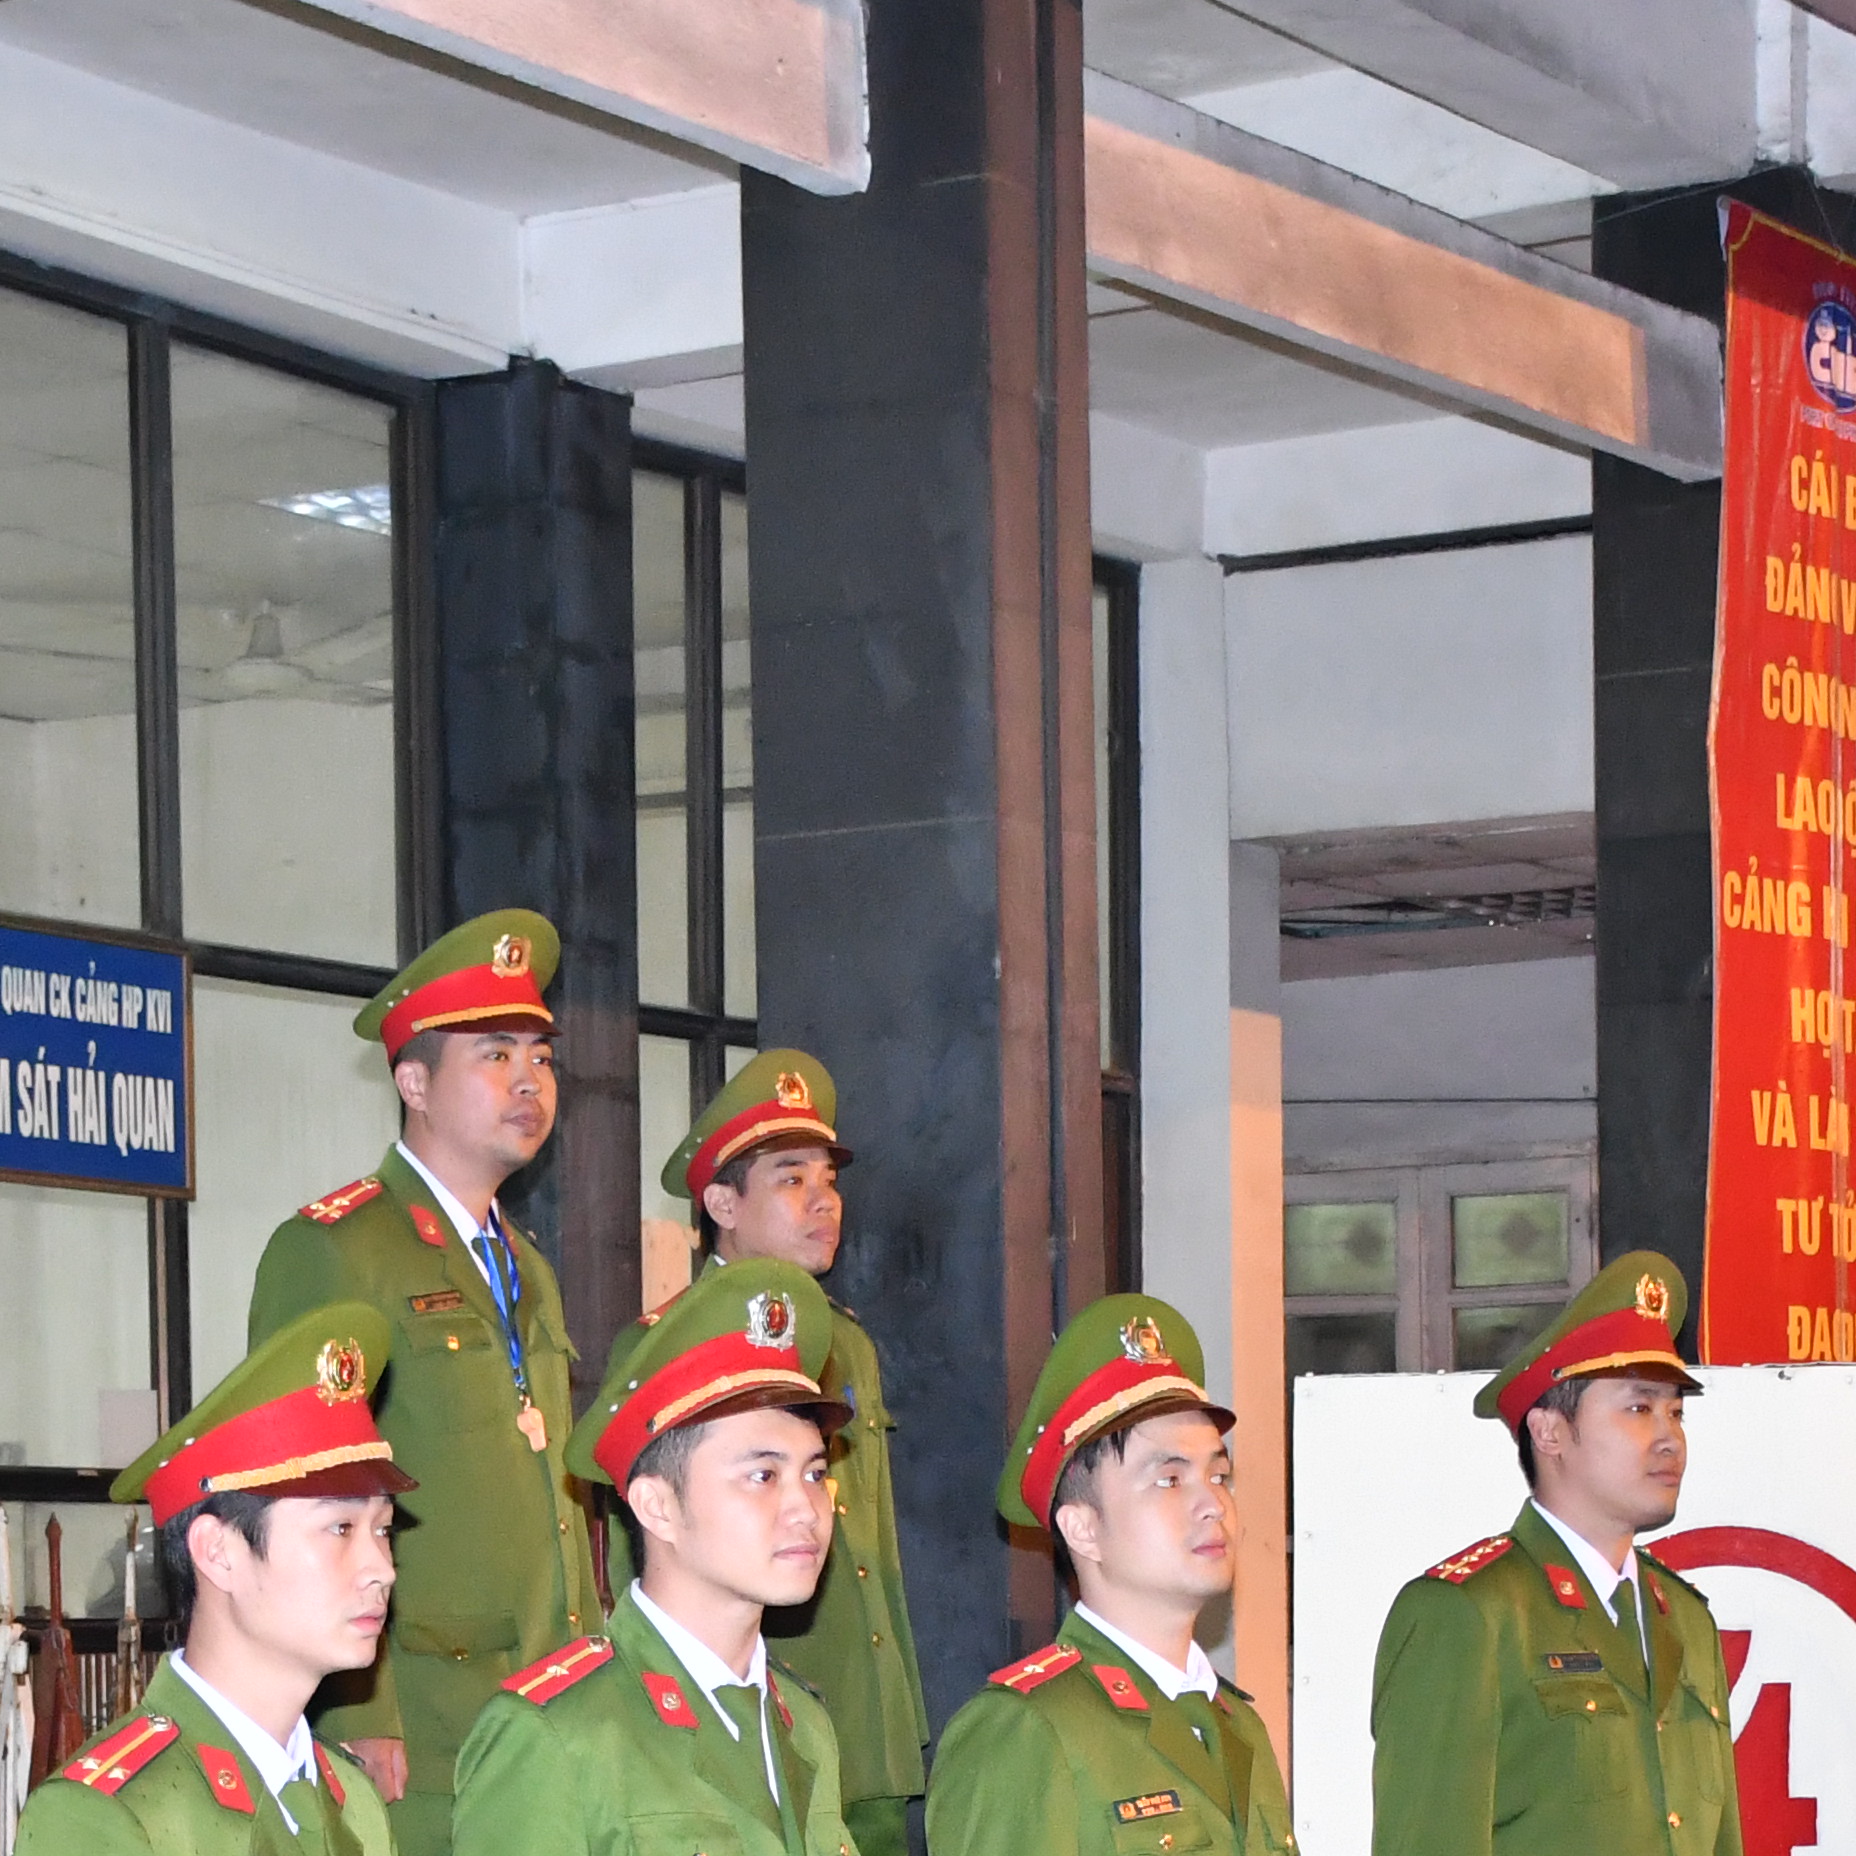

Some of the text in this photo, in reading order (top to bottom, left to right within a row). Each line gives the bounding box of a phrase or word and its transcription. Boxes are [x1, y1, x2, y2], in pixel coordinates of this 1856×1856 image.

[1723, 855, 1812, 938] CẢNG
[1823, 884, 1849, 949] HI
[1, 964, 46, 1016] QUAN
[49, 972, 73, 1020] CK
[75, 960, 119, 1027] CẢNG
[121, 983, 144, 1030] HP
[1791, 987, 1840, 1059] HỌ
[17, 1045, 62, 1141] SÁT
[67, 1039, 108, 1146] HẢI
[112, 1071, 176, 1158] QUAN
[1750, 1079, 1798, 1148] VÀ
[1809, 1085, 1850, 1158] LÀ
[1776, 1195, 1825, 1256] TƯ
